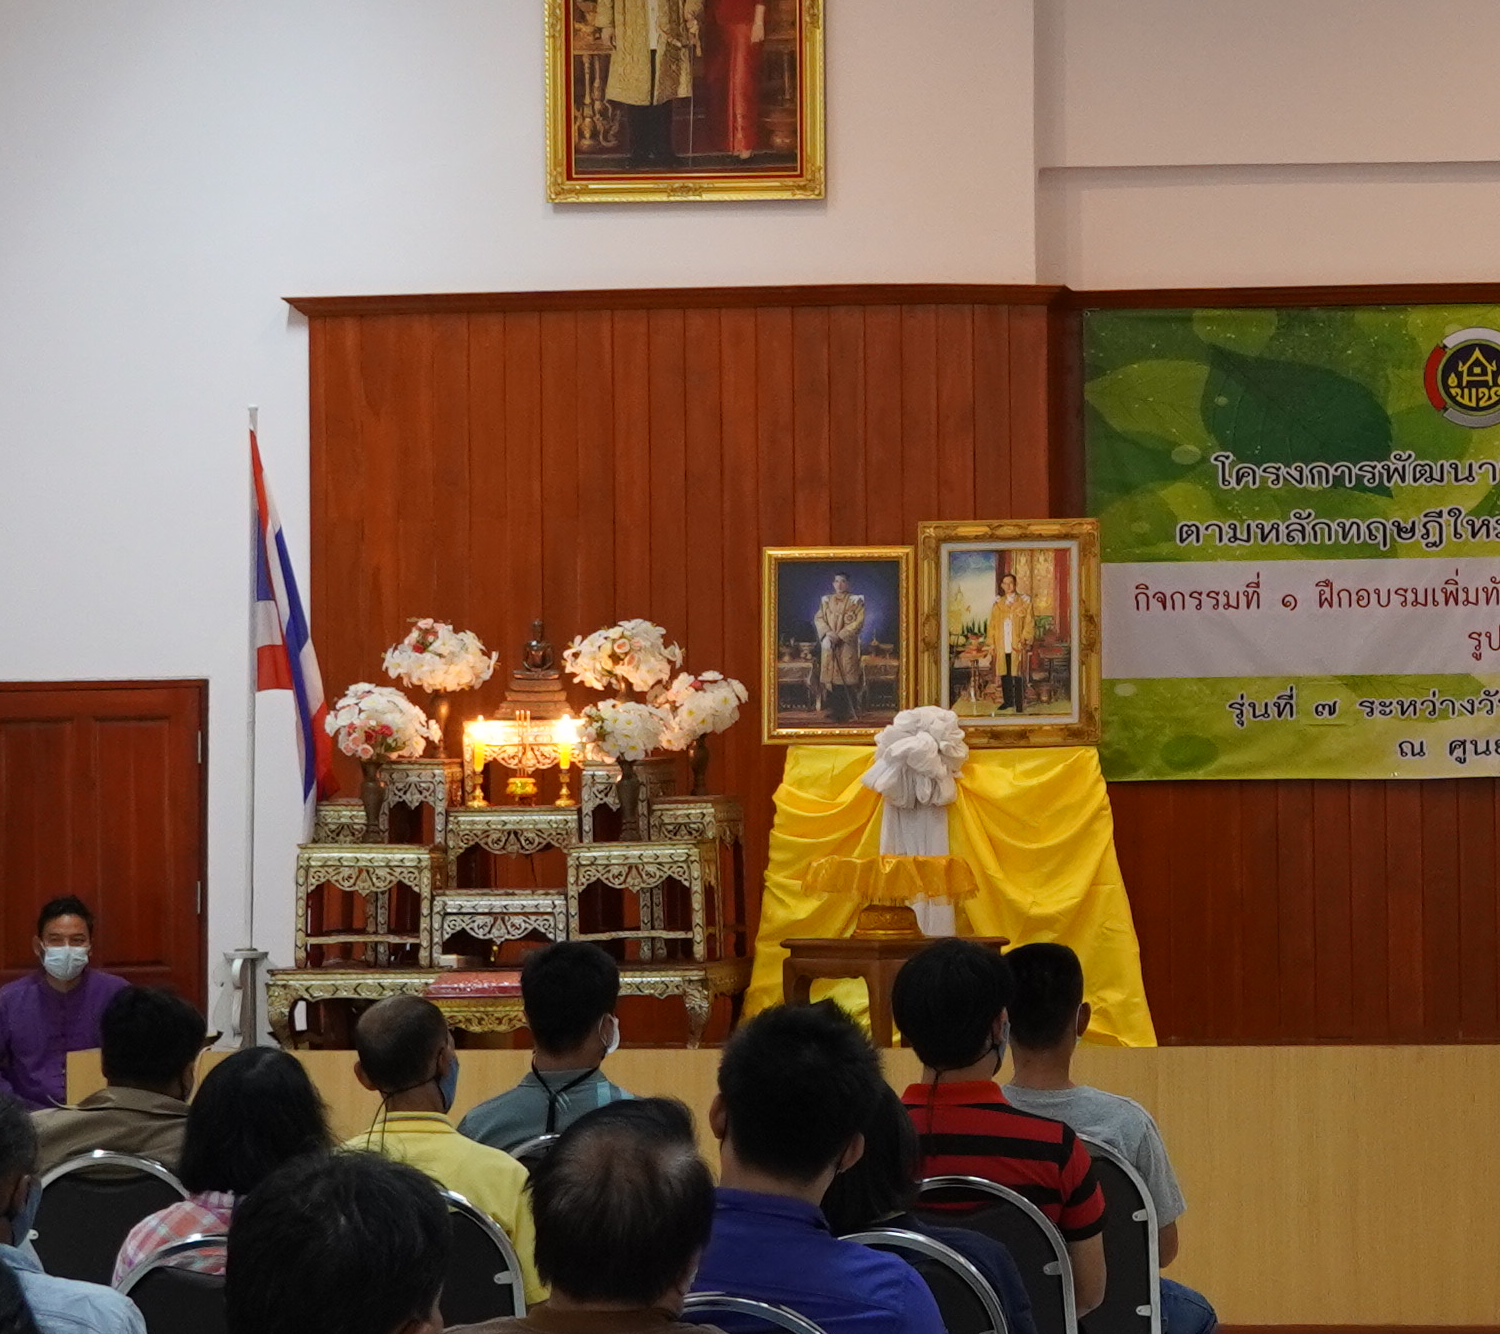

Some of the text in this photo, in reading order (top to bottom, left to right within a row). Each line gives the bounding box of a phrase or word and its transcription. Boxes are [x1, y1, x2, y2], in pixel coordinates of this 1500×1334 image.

[1134, 573, 1262, 612] กิจกรรมที่
[1280, 593, 1298, 611] ๑
[1229, 685, 1296, 727] รุ่นที่
[1314, 698, 1339, 719] ๗
[1398, 735, 1426, 758] ณ
